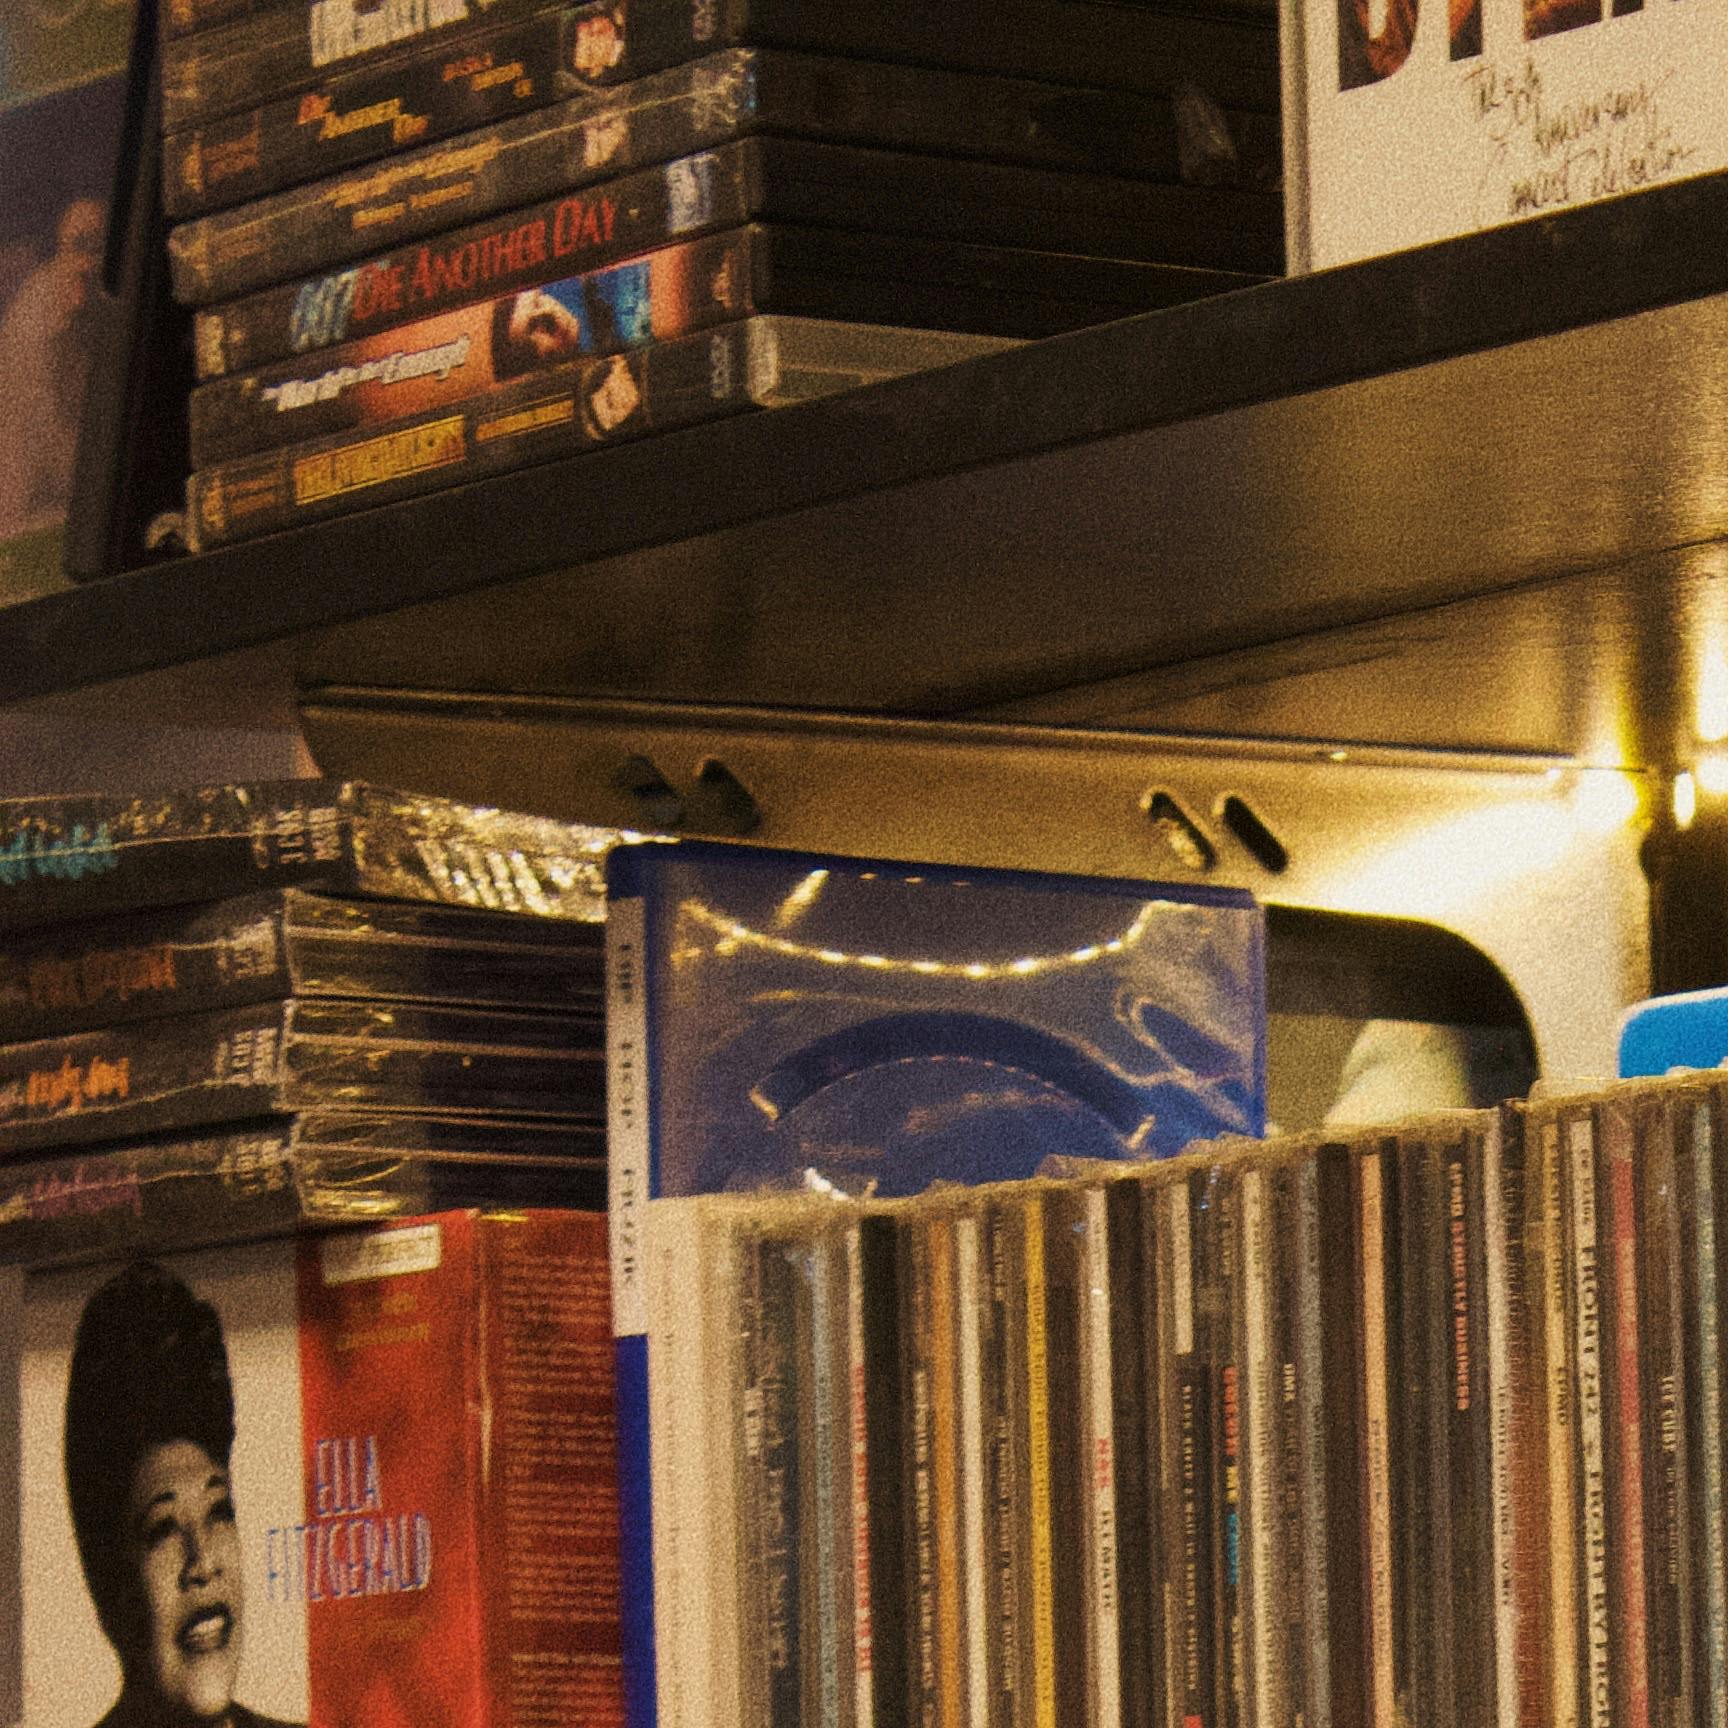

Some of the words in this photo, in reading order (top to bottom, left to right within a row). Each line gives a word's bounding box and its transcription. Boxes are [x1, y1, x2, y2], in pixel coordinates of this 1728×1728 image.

[352, 262, 410, 320] DIE
[411, 217, 547, 299] ANOTHER
[552, 198, 619, 253] DAY
[1579, 1244, 1601, 1355] FRONT
[315, 1435, 383, 1517] ELLA
[1586, 1469, 1607, 1580] FRONT
[266, 1511, 432, 1602] FITZGERALD
